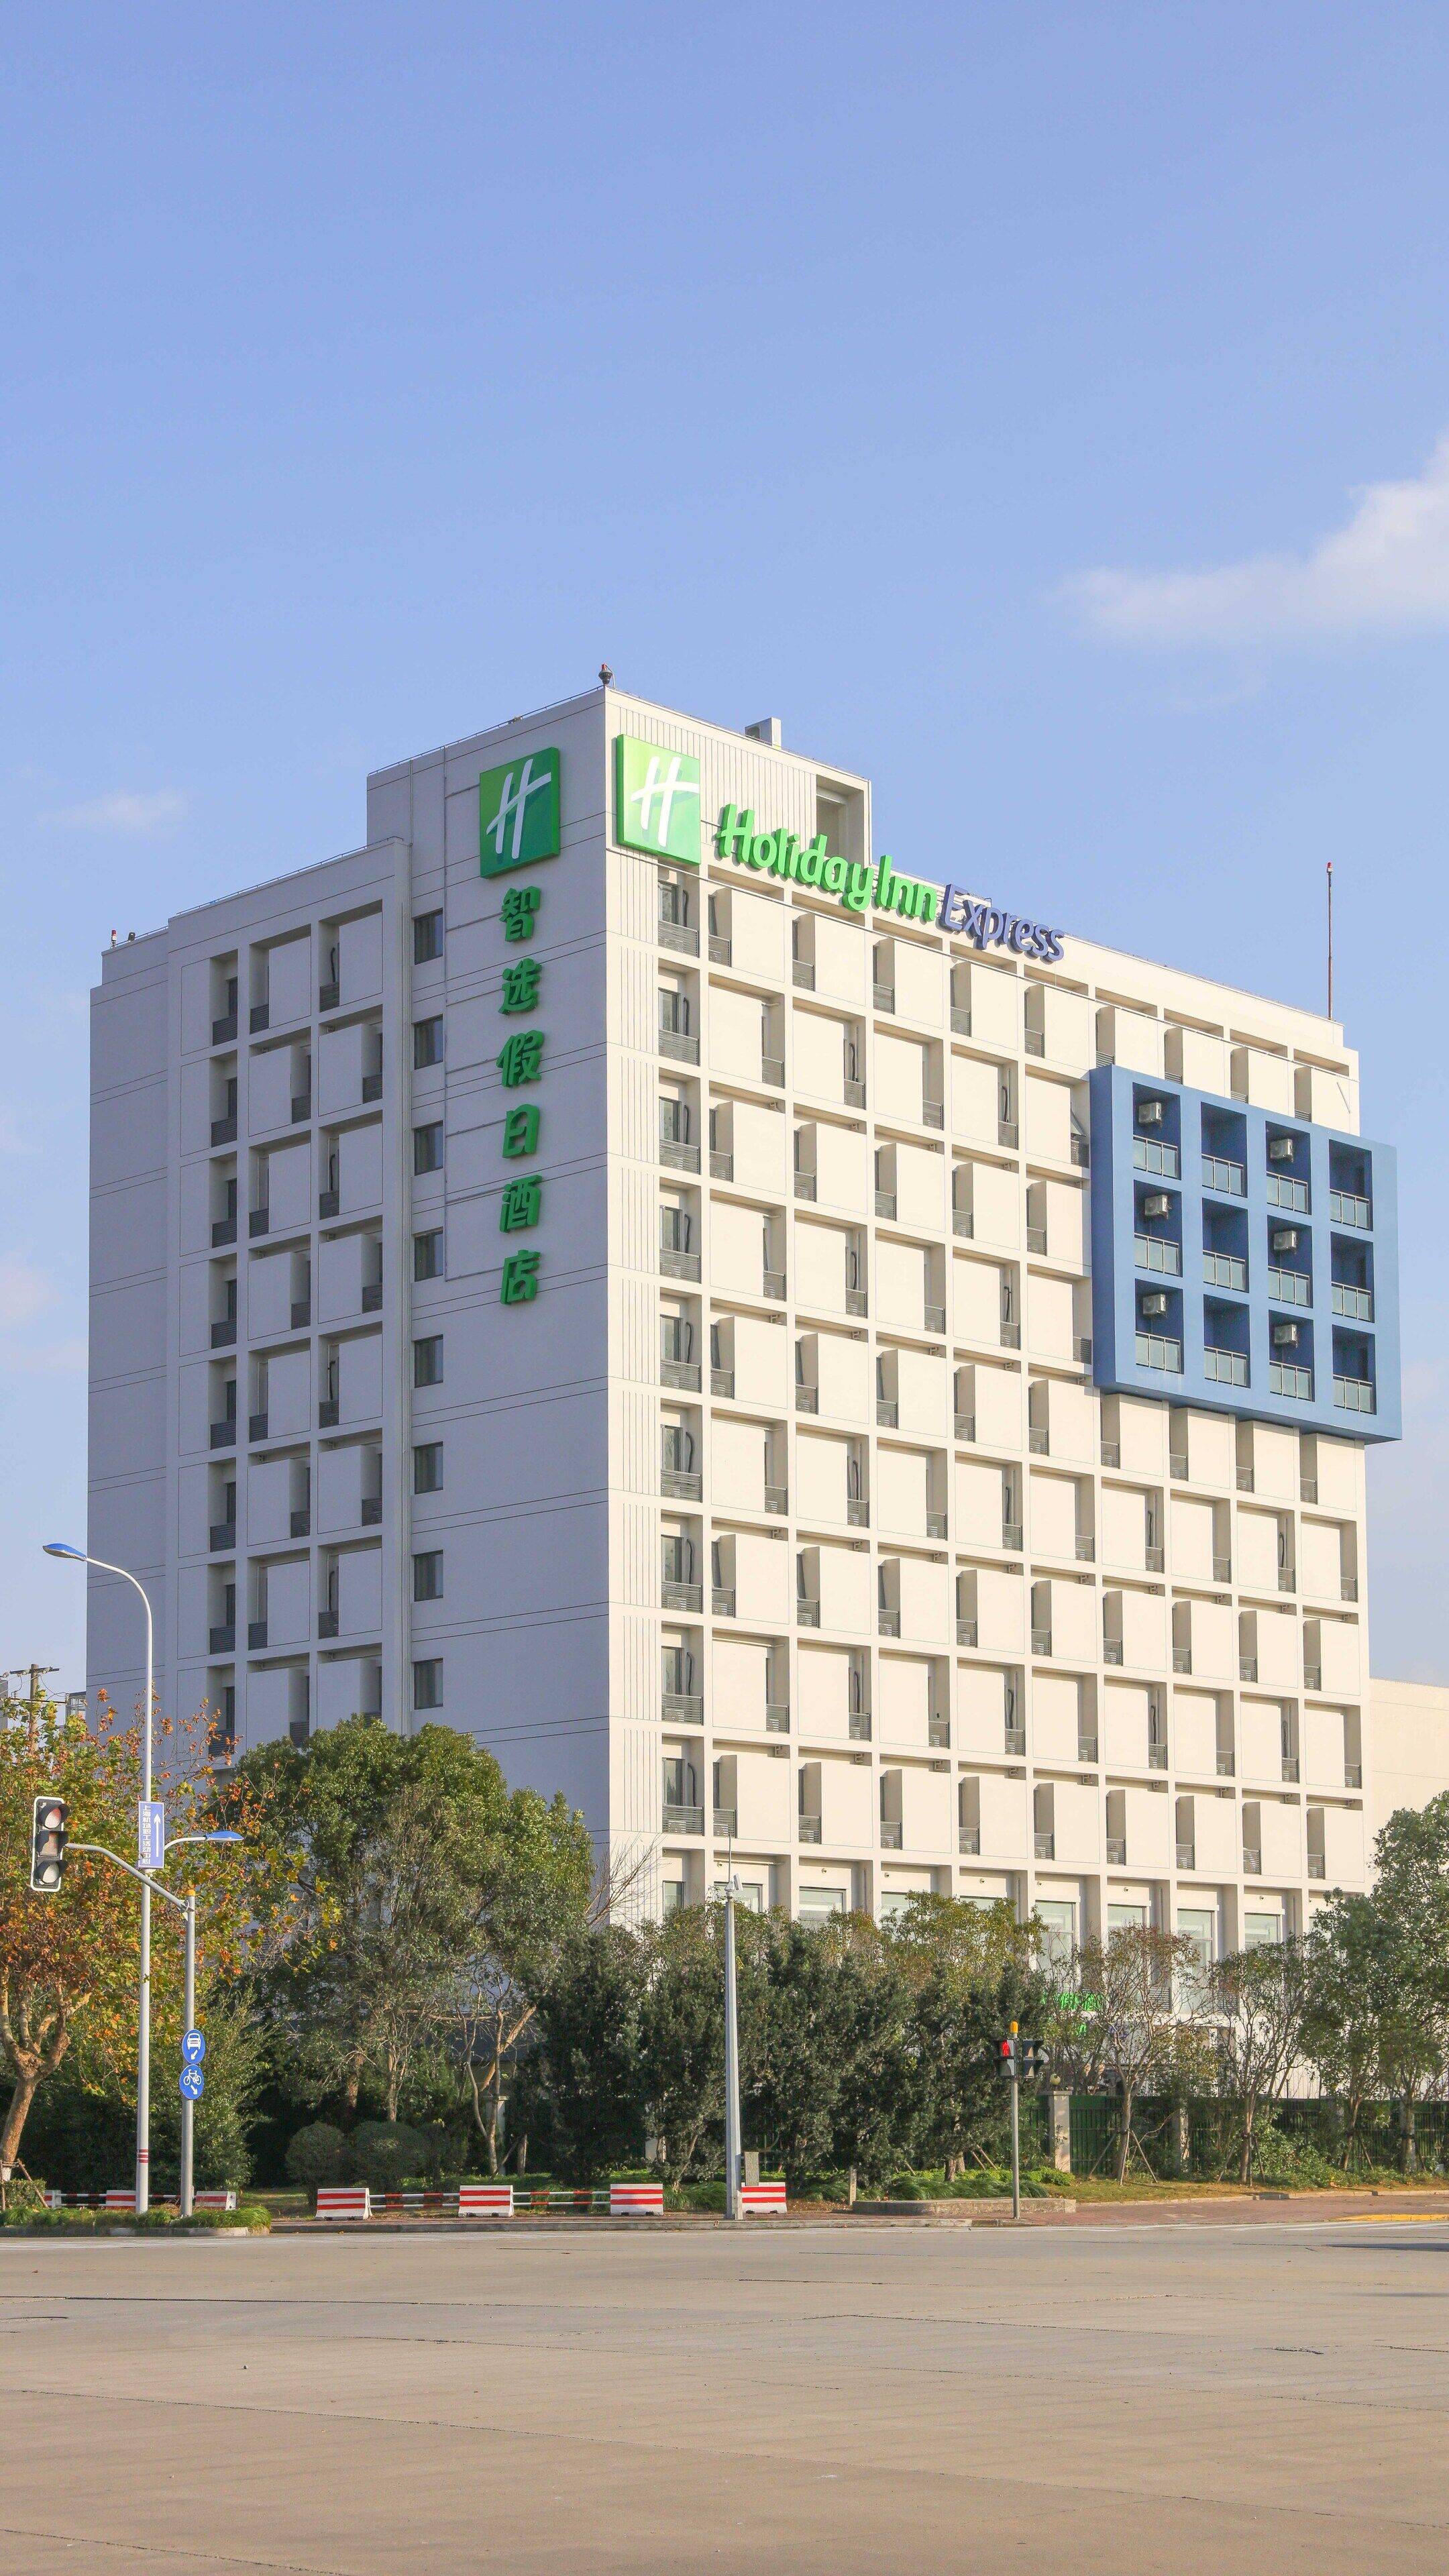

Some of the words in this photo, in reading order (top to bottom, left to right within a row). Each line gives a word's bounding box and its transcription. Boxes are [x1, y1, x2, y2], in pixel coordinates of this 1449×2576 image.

[716, 804, 873, 912] Holiday
[875, 855, 937, 922] Inn
[941, 883, 1065, 963] Express
[496, 886, 545, 1305] 智选假日酒店
